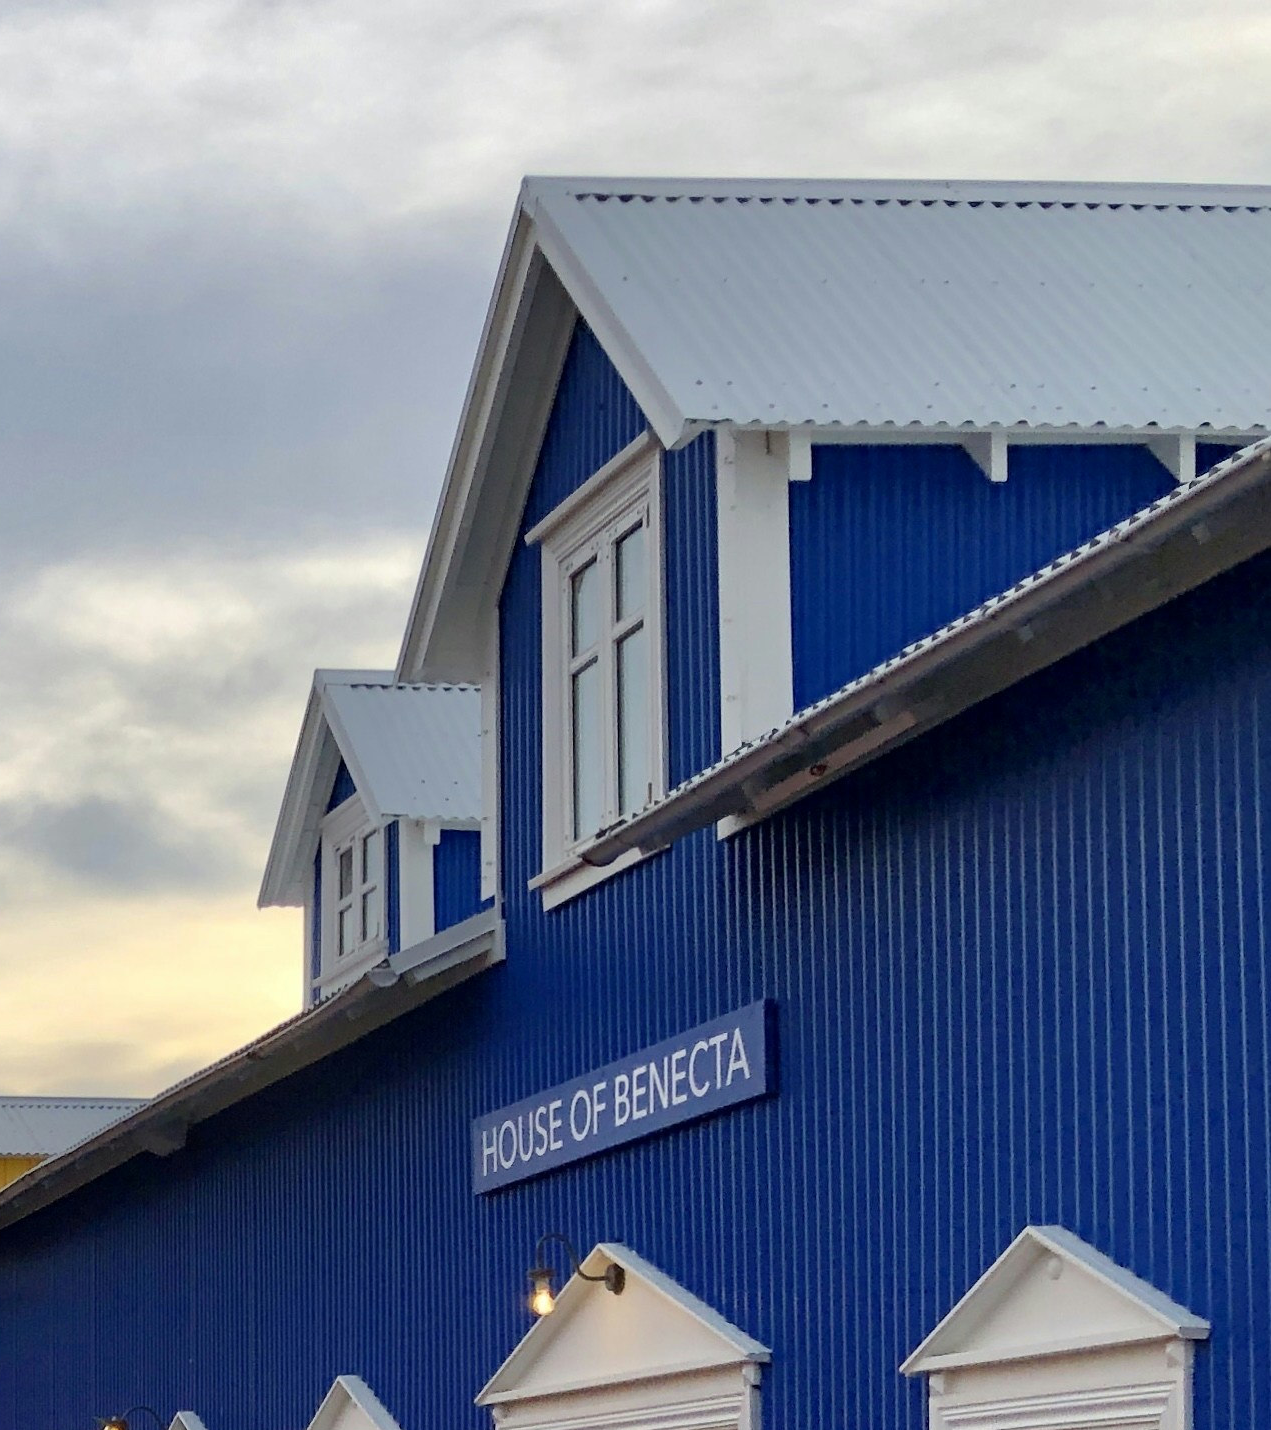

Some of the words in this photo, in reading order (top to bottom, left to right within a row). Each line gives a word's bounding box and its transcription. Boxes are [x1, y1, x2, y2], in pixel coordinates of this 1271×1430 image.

[482, 1100, 563, 1177] HOUSE
[570, 1081, 607, 1142] OF
[614, 1027, 751, 1127] BENECTA
